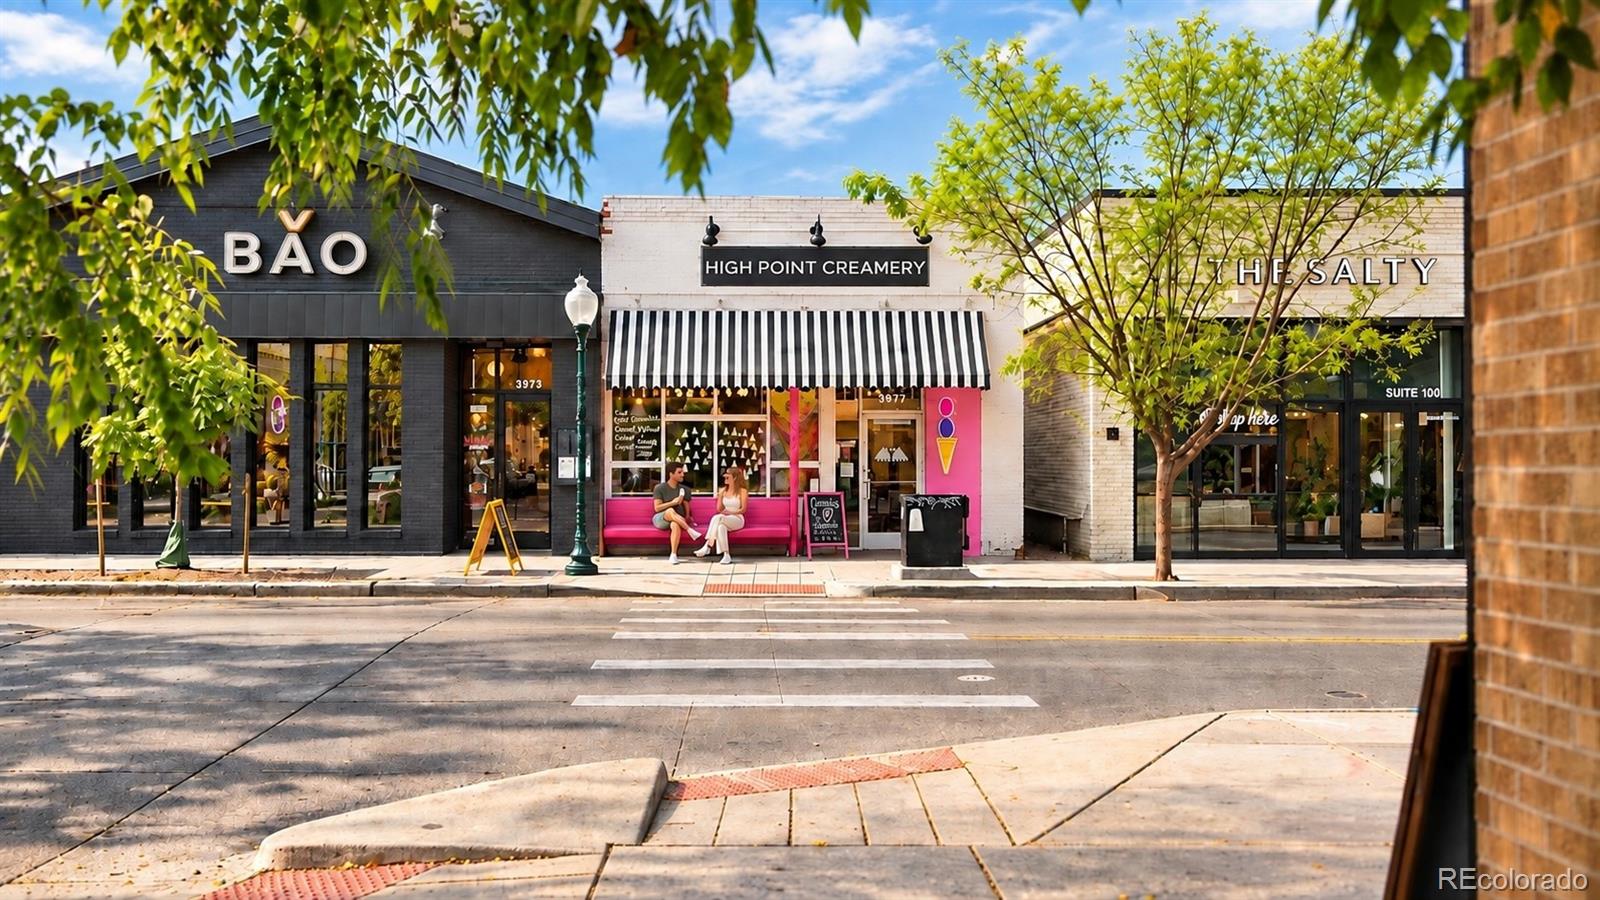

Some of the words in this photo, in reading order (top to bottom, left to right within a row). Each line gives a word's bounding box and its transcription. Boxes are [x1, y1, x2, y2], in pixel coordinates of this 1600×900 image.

[705, 260, 752, 275] HIGH
[758, 260, 817, 275] POINT
[822, 260, 926, 275] CREAMERY
[1207, 257, 1294, 286] THE
[1306, 257, 1438, 286] SALTY
[515, 379, 543, 389] 3973
[1385, 387, 1419, 398] SUITE
[1421, 387, 1440, 398] 100
[1247, 406, 1280, 426] here
